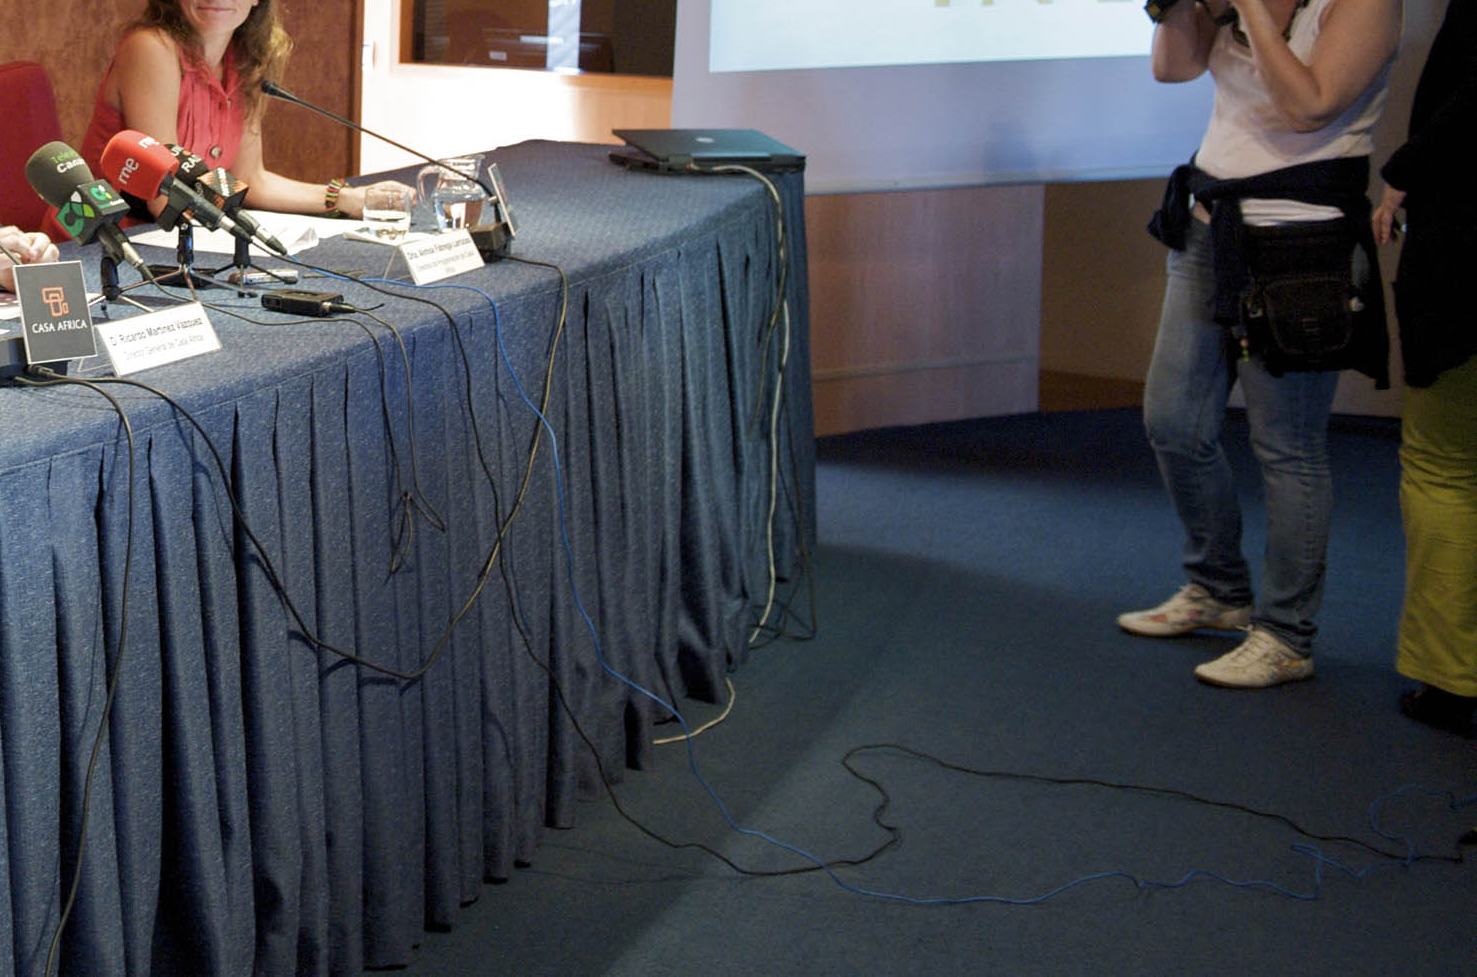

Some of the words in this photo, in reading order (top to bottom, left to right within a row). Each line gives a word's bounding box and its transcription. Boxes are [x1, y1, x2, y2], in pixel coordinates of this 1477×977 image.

[118, 157, 140, 185] rne
[32, 322, 56, 334] CASA
[57, 319, 88, 331] AFRICA
